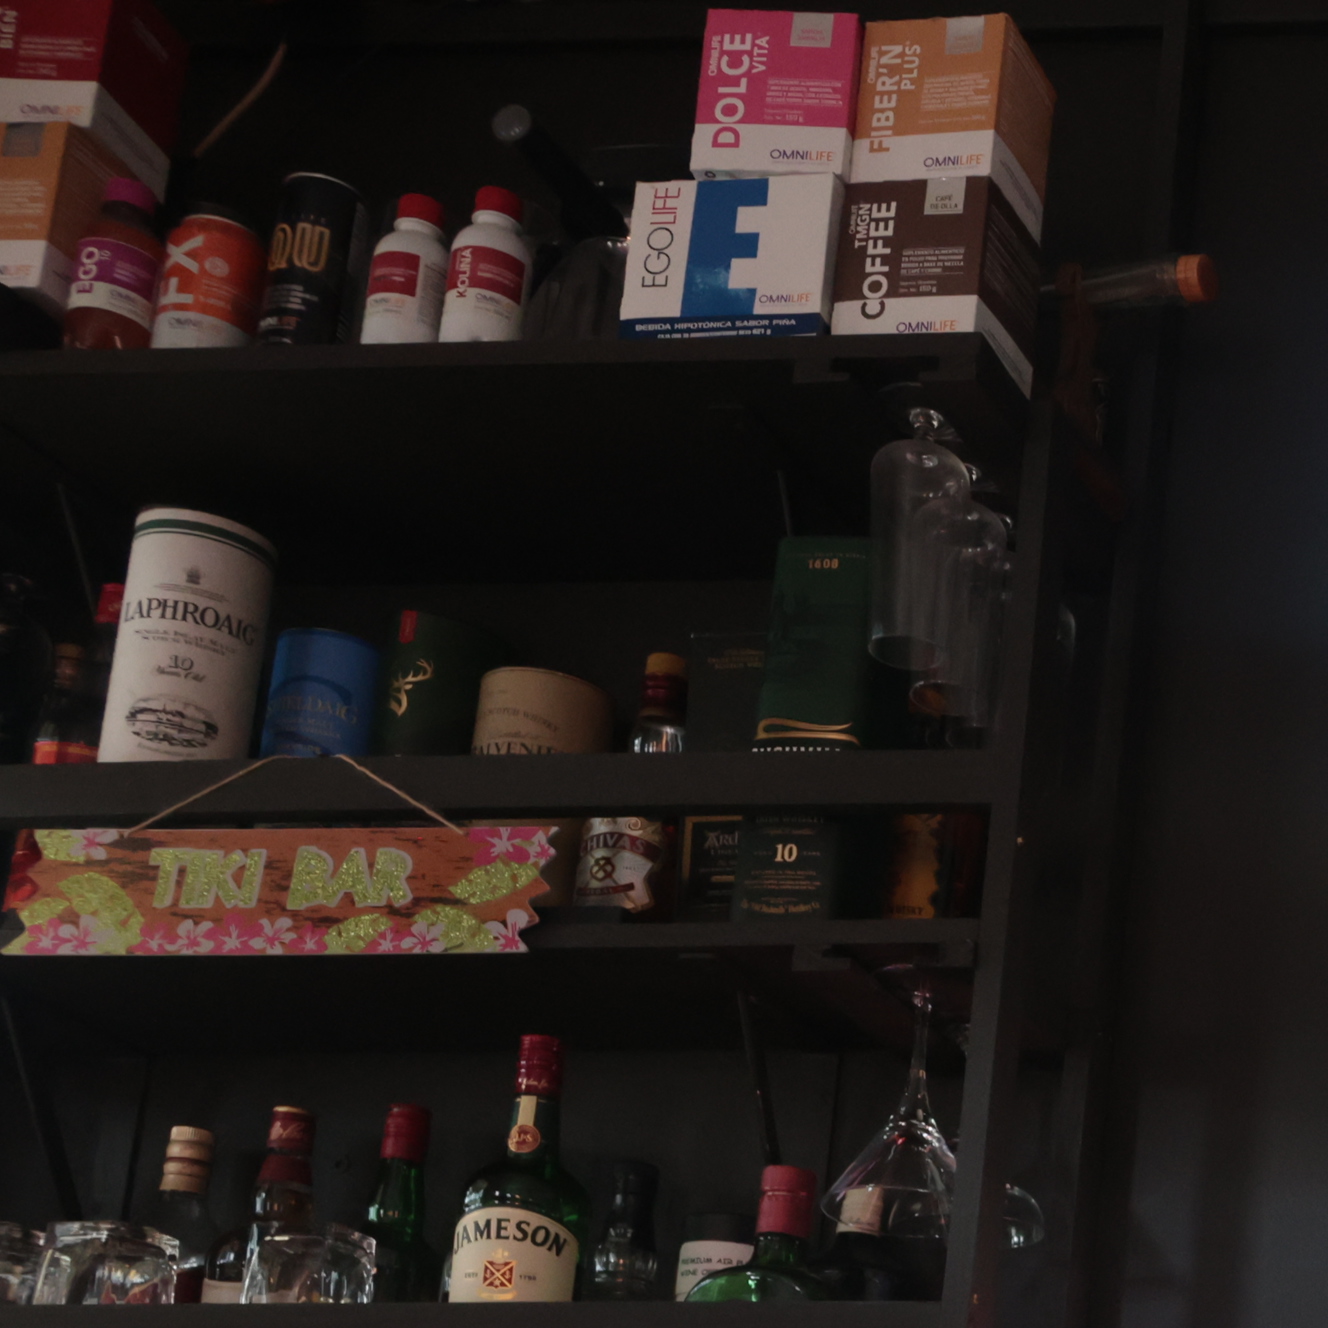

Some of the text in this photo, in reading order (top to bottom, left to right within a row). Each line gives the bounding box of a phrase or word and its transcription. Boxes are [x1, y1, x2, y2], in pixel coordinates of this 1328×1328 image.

[752, 36, 770, 74] VITA
[900, 44, 921, 90] PLUS
[712, 33, 753, 148] DOLCE
[869, 44, 904, 153] FIBER'N
[769, 148, 834, 162] OMNILIFE
[923, 154, 983, 168] OMNILIFE
[641, 187, 682, 288] EGOLIFE
[861, 201, 897, 319] COFFEE
[455, 248, 473, 298] KOLINA
[758, 292, 812, 304] OMNILIFE
[896, 320, 957, 334] OMNILIFE
[122, 597, 256, 647] LAPHROAIG
[774, 843, 798, 862] 10
[149, 845, 413, 910] TIKI BAR
[453, 1218, 566, 1257] JAMESON
